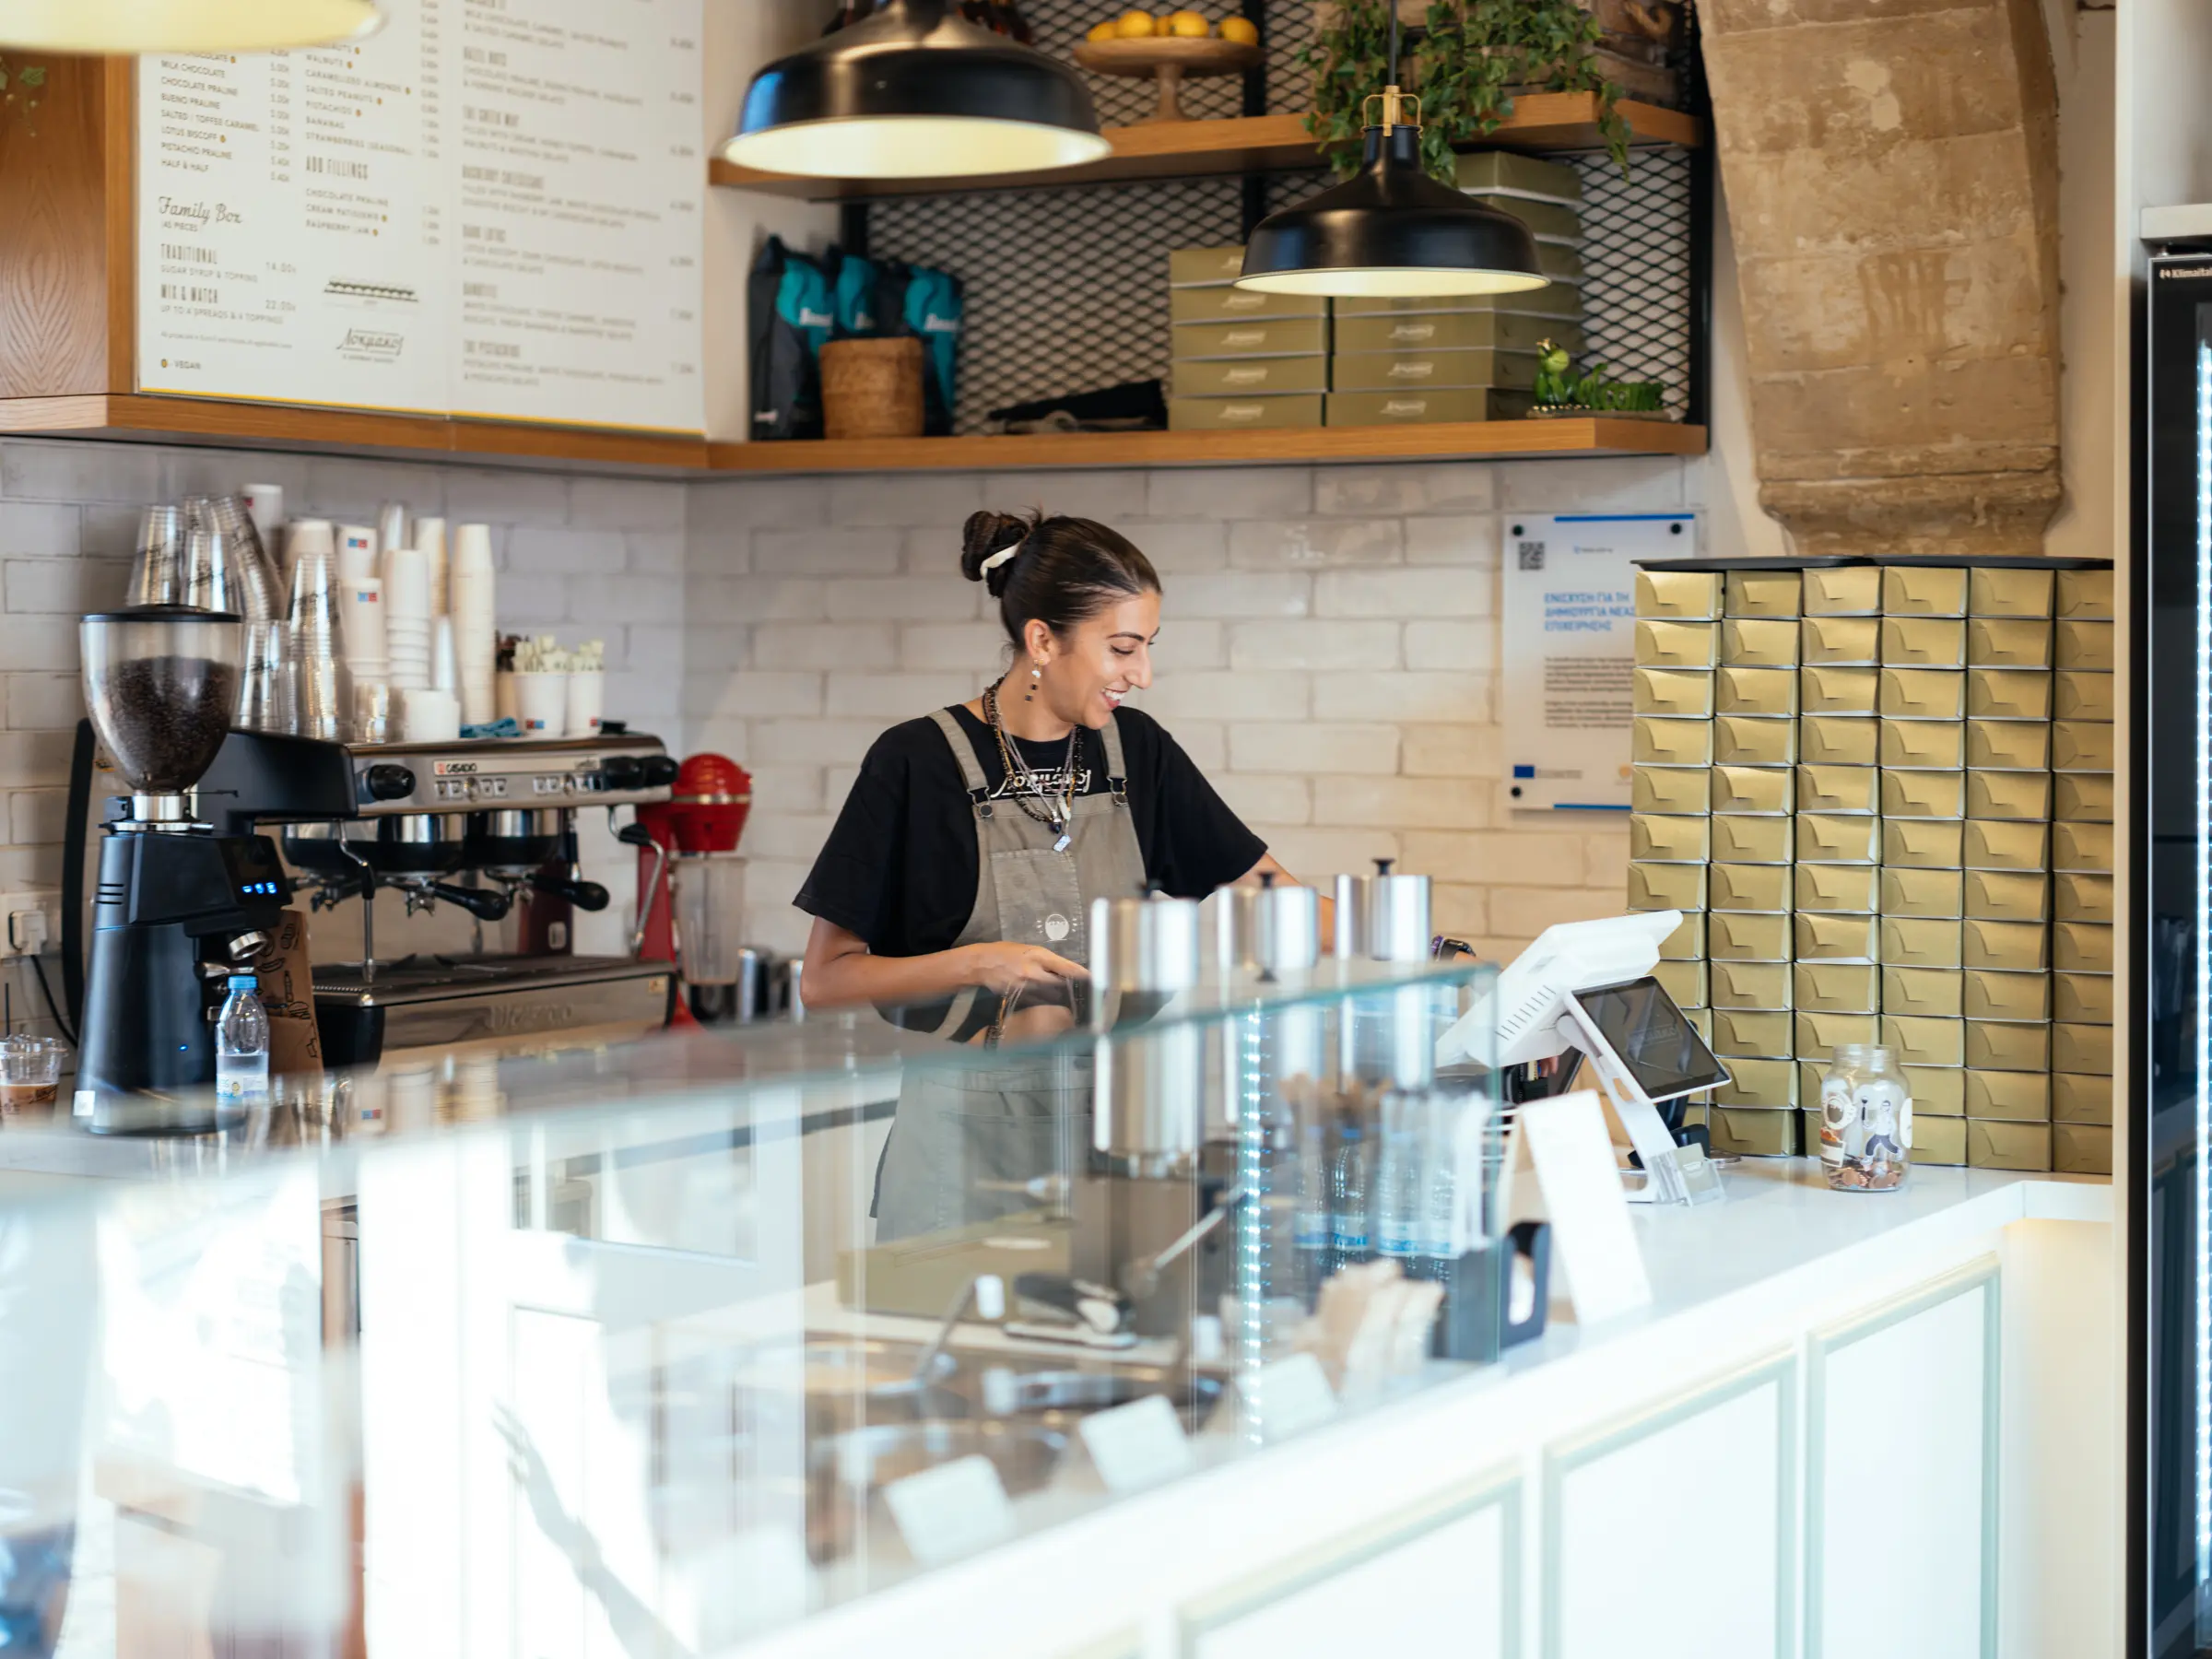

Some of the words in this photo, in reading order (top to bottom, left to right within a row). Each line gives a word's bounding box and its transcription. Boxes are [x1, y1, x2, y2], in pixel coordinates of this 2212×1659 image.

[161, 60, 178, 69] MILK
[181, 63, 226, 78] CHOCOLATE
[160, 76, 206, 91] CHOCOLATE
[207, 84, 238, 96] PRALINE
[160, 93, 187, 104] BUENO
[190, 98, 220, 110] PRALINE
[160, 109, 188, 121] SALTED
[161, 125, 185, 136] LOTUS
[160, 142, 199, 155] PISTACHIO
[202, 147, 232, 159] PRALINE
[161, 158, 181, 168] HALF
[190, 163, 209, 172] HALF
[159, 195, 211, 225] Family
[216, 203, 243, 225] Box
[160, 243, 218, 265] TRADITIONAL
[160, 265, 187, 275] SUGAR
[160, 283, 177, 300] MIX
[191, 287, 218, 304] MATCH
[160, 304, 171, 312] UP
[173, 306, 183, 314] TO
[173, 360, 201, 371] VEGAN
